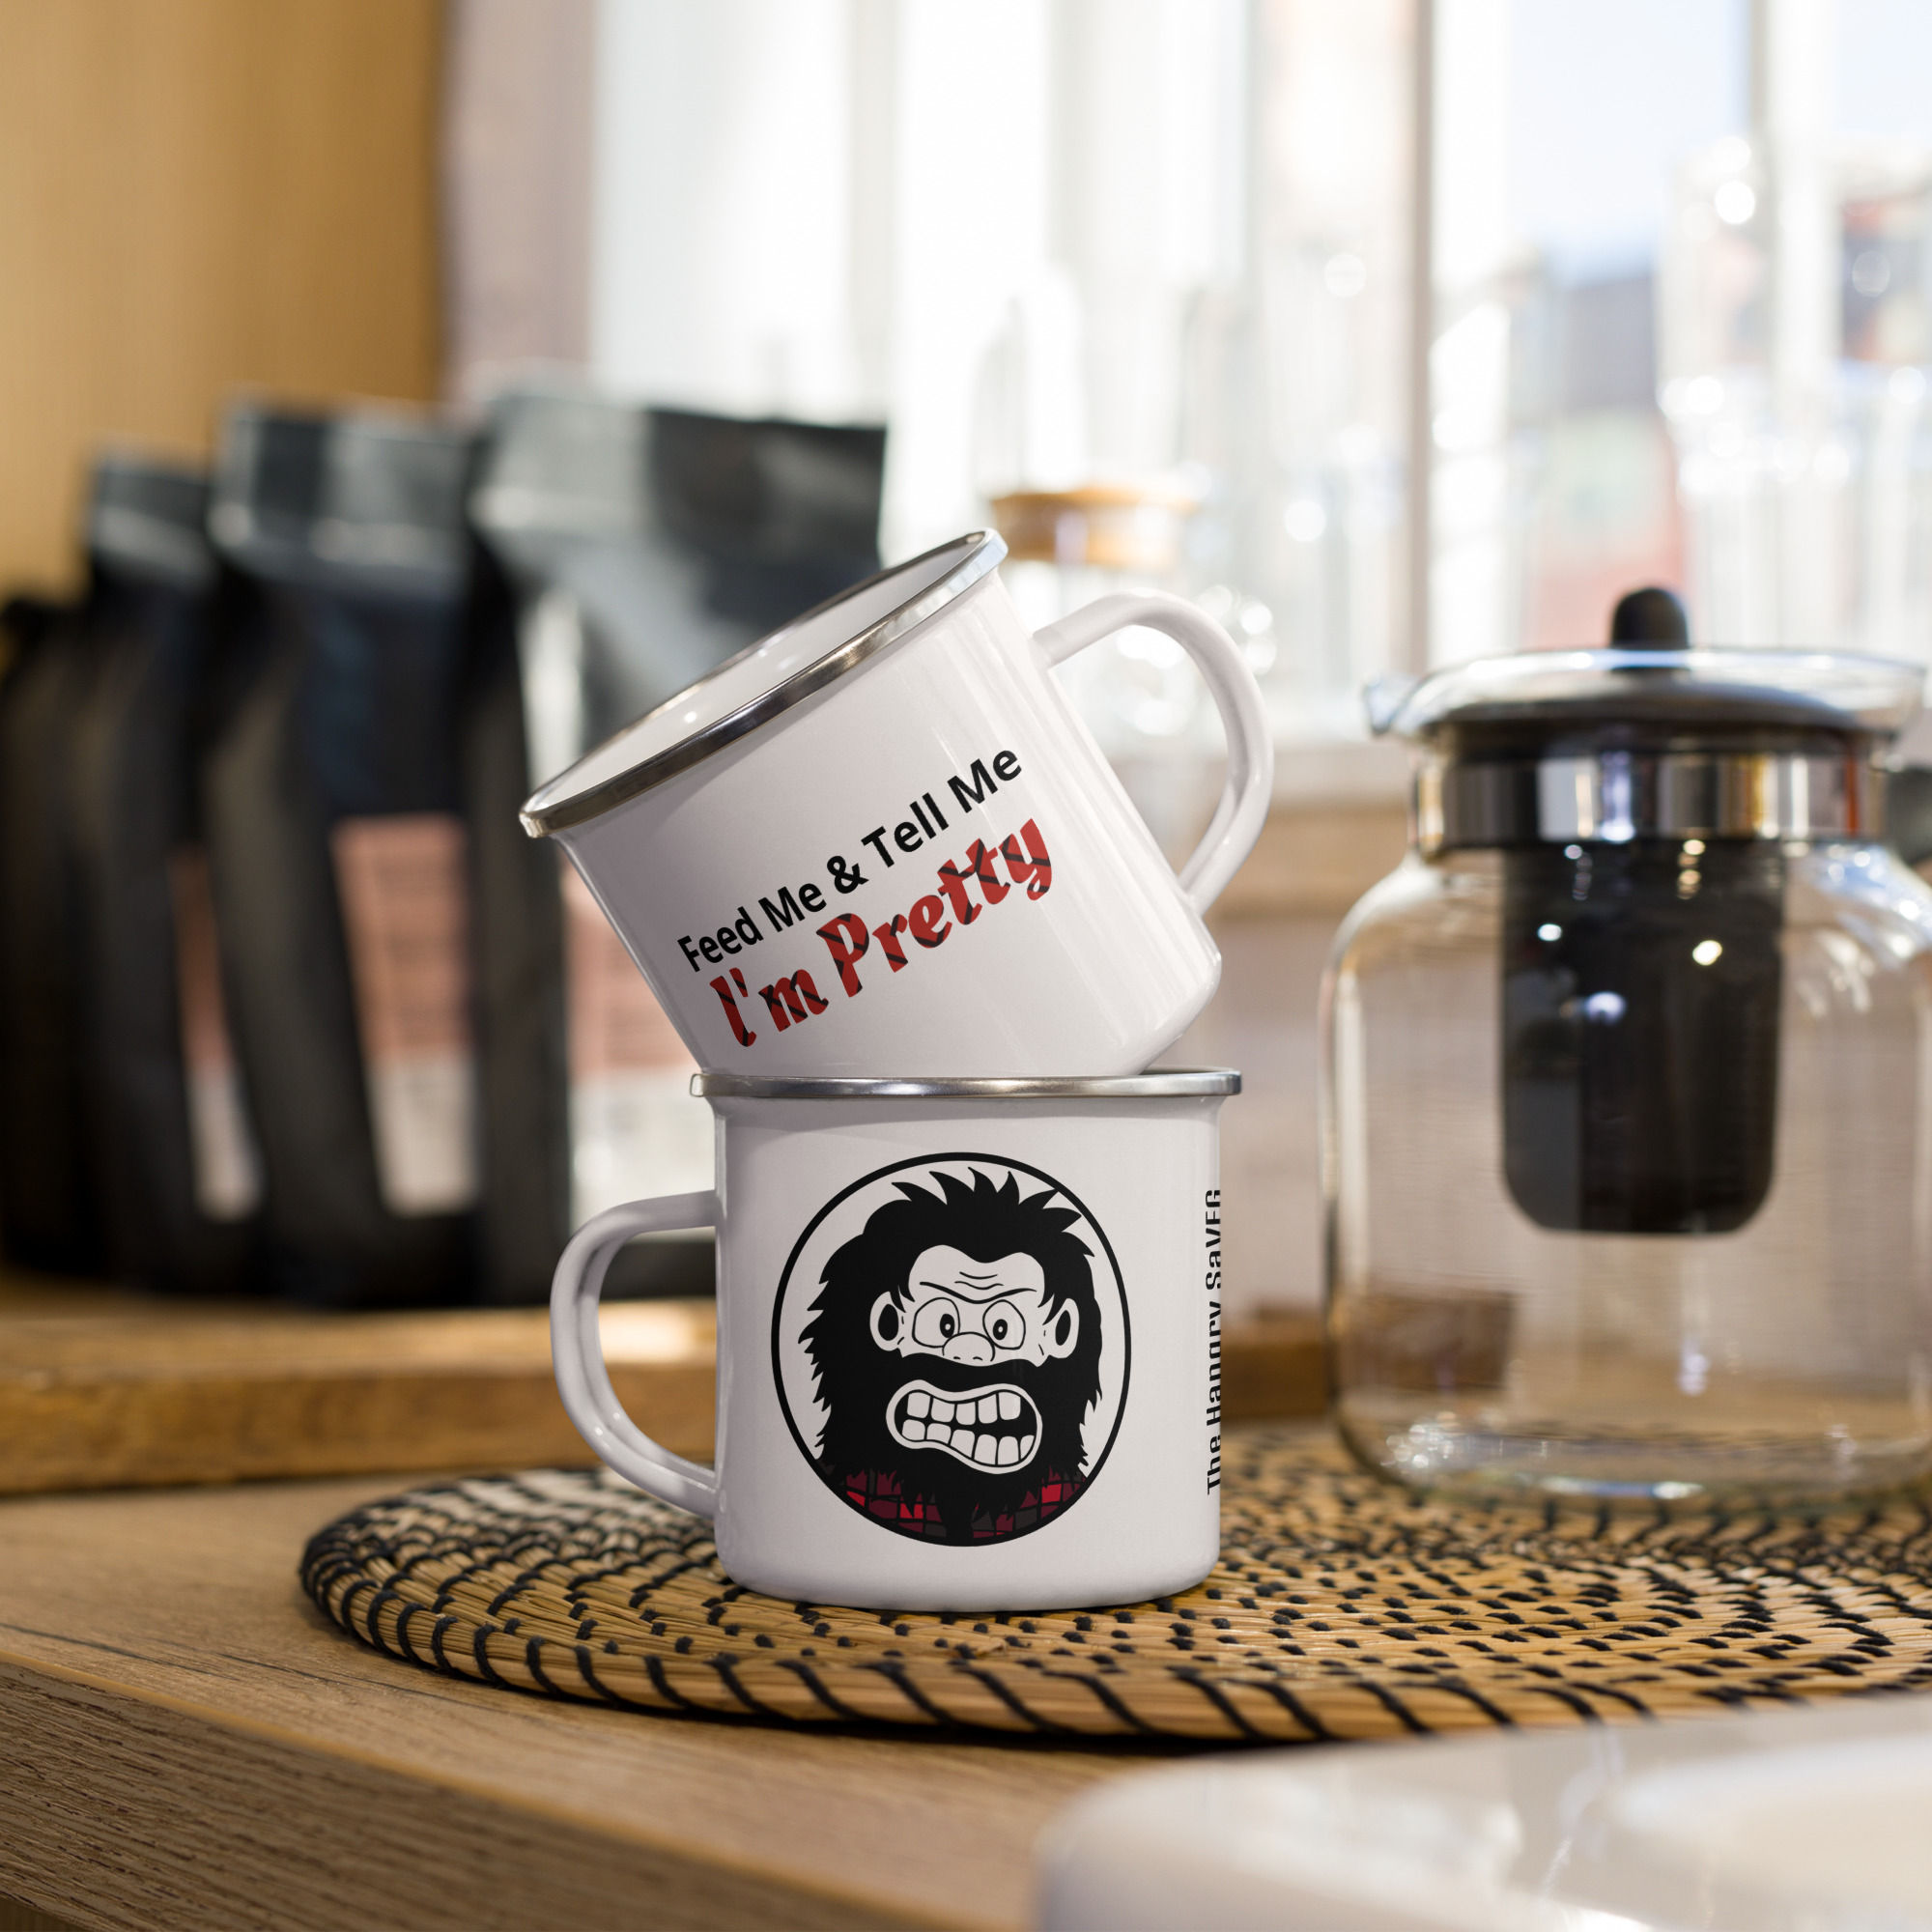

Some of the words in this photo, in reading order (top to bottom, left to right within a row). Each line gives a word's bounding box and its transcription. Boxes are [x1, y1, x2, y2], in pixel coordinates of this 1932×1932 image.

[676, 905, 764, 973] Feed
[757, 882, 827, 933] Me
[826, 855, 869, 895] &
[860, 792, 950, 868] Tell
[947, 749, 1022, 813] Me
[709, 966, 830, 1048] I'm
[815, 817, 1053, 998] Pretty
[1207, 1435, 1221, 1495] The
